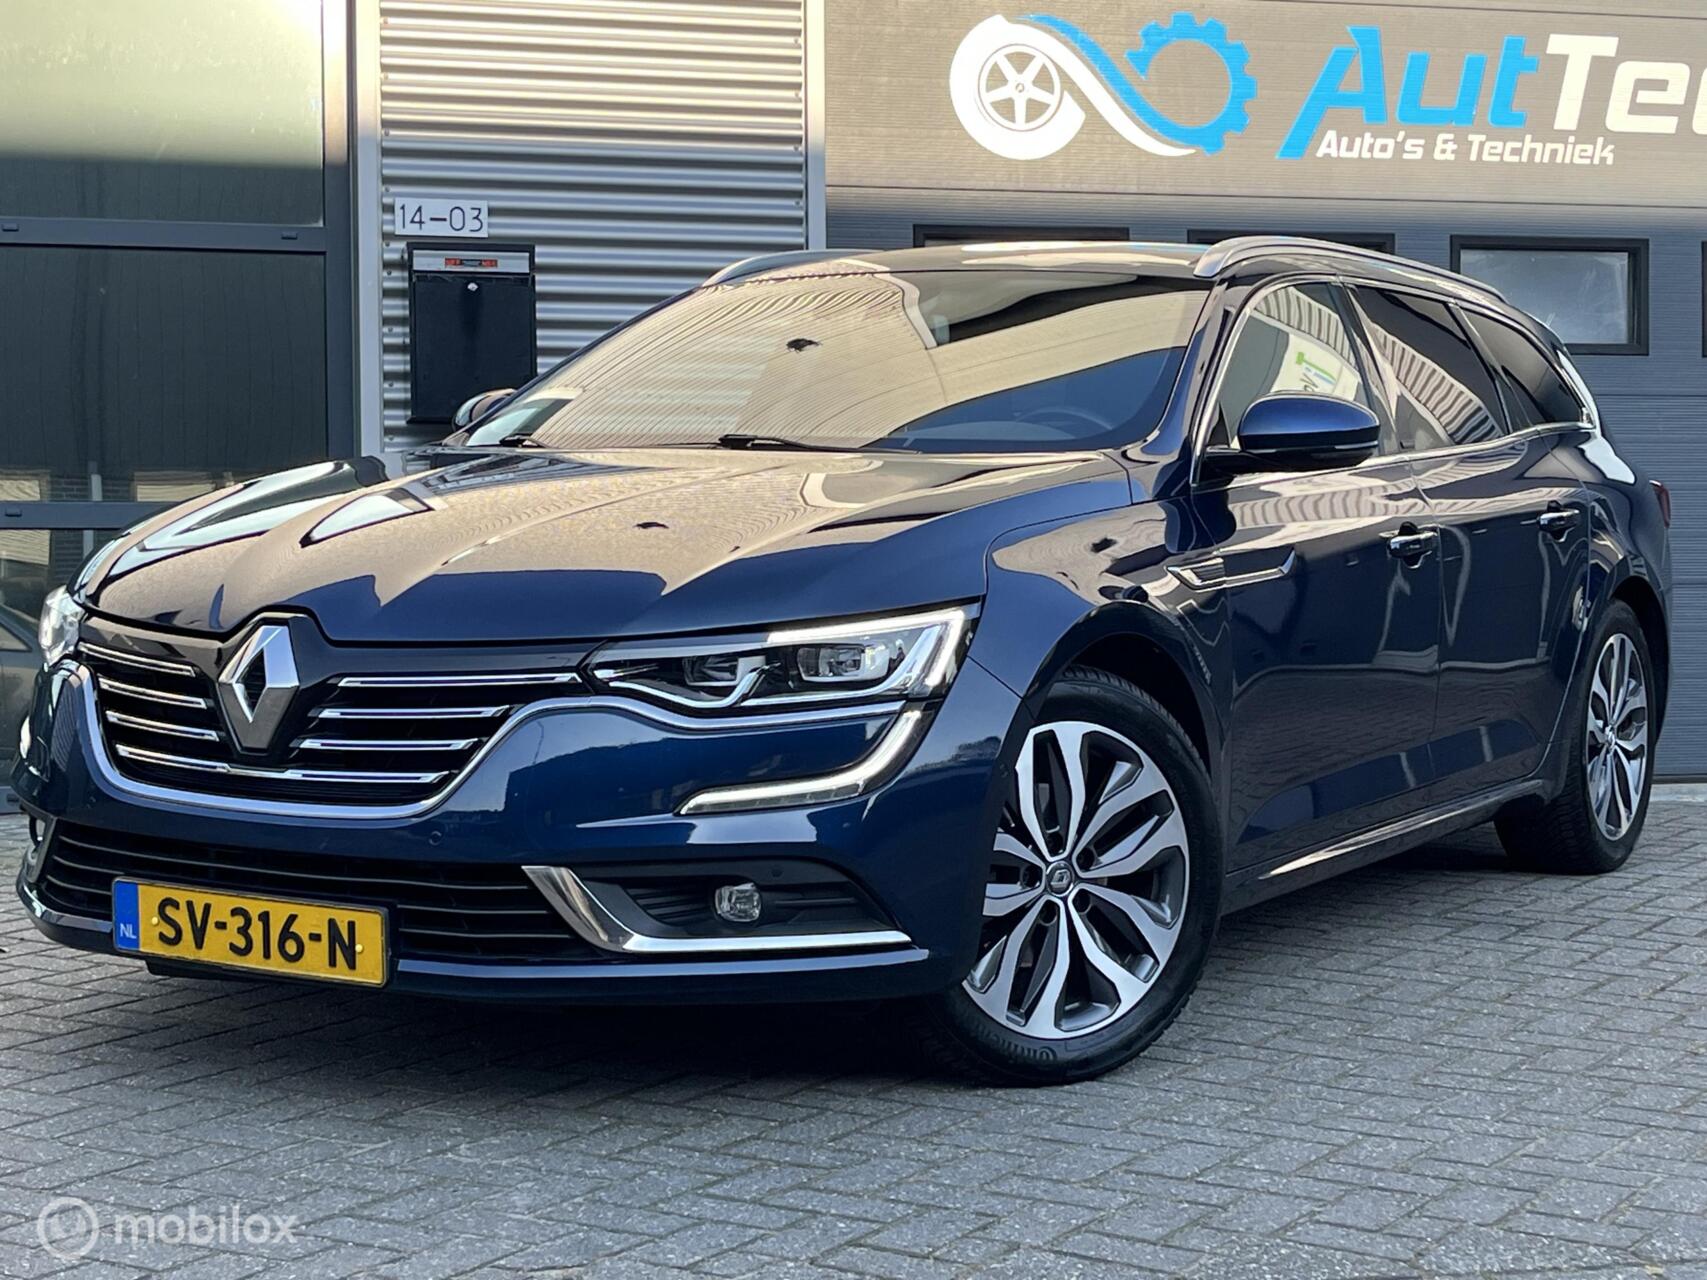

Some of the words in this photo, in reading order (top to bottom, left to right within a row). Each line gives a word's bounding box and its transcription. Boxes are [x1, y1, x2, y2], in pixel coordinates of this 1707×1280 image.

[1275, 24, 1707, 160] AutTe
[1316, 129, 1425, 160] Auto's
[1433, 133, 1458, 161] &
[1467, 133, 1615, 166] Techniek
[399, 203, 484, 232] 14-03
[119, 922, 137, 940] NL
[157, 897, 357, 971] SV-316-N
